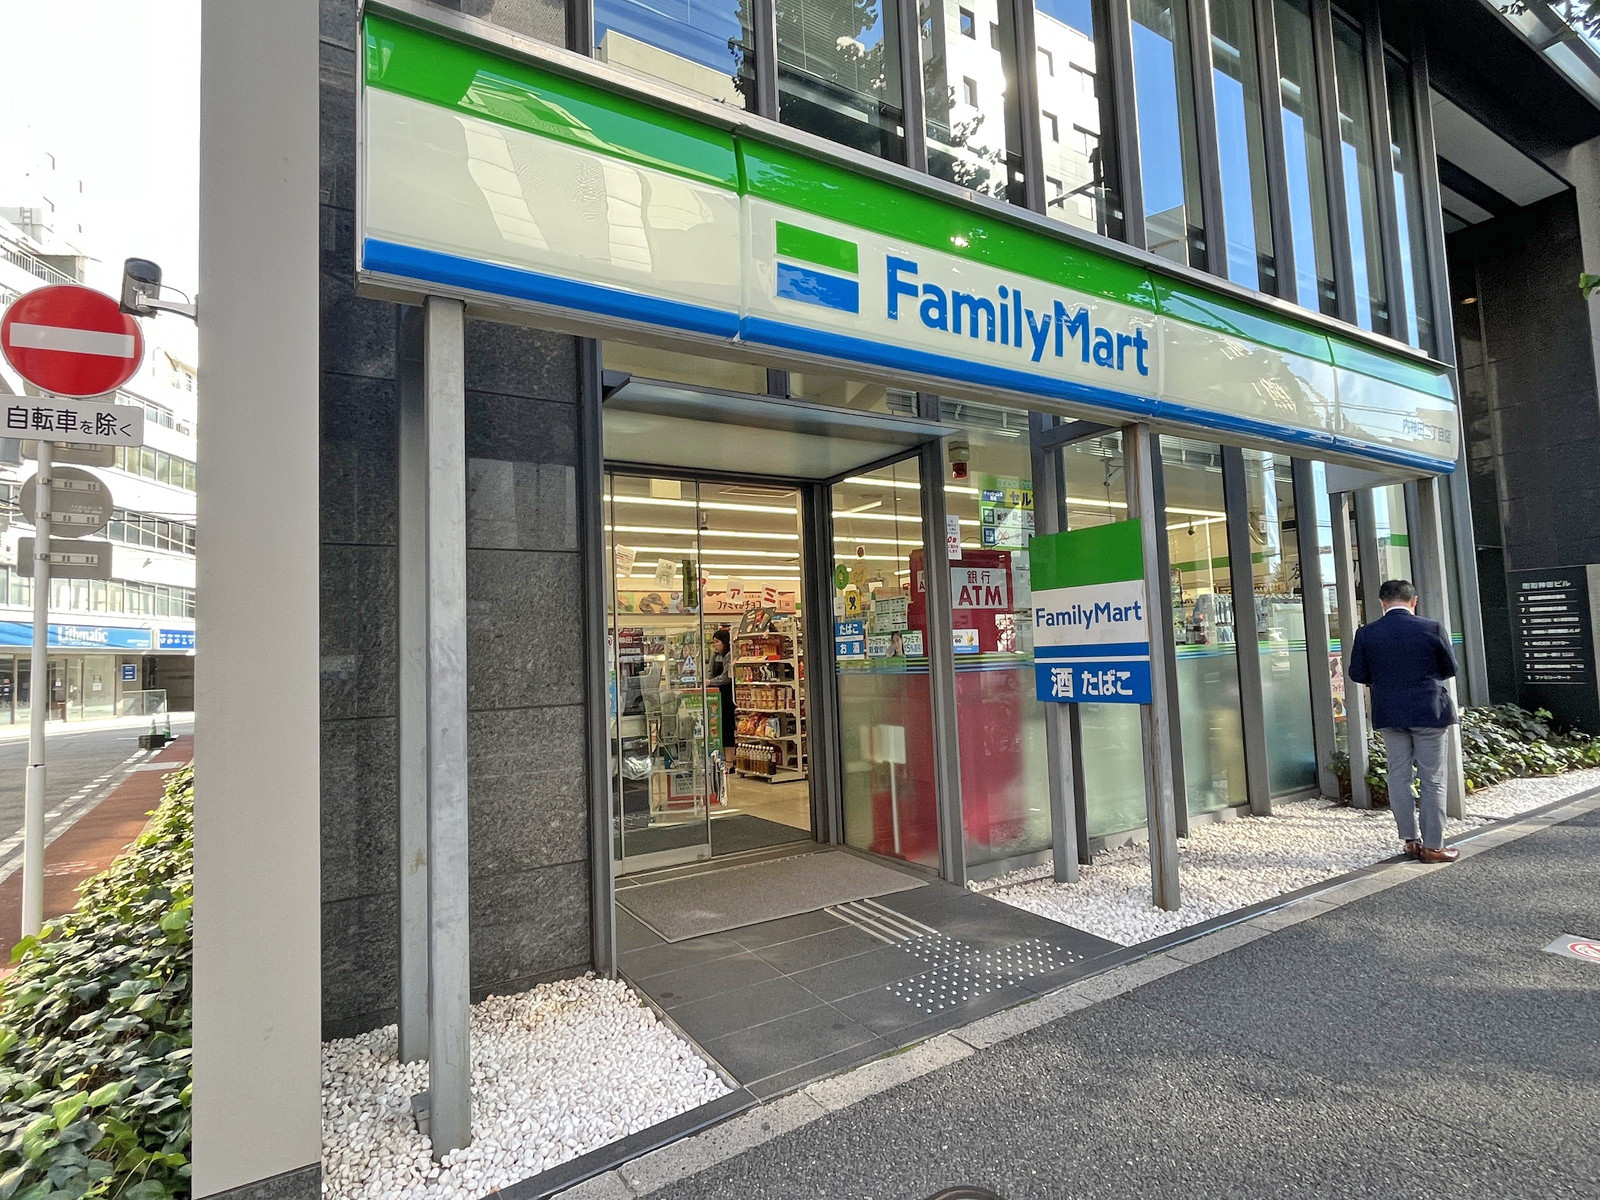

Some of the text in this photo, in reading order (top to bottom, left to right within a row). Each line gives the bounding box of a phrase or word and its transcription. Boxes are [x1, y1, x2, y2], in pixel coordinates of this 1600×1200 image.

[885, 254, 1149, 376] FamilyMart
[6, 405, 132, 437] 自転車を除く
[966, 570, 991, 584] 銀行
[958, 586, 1003, 606] ATM
[1035, 600, 1142, 629] FamilyMart
[58, 626, 109, 643] Lithmatic
[839, 624, 859, 635] たばこ
[1051, 667, 1133, 697] 酒 たばこ
